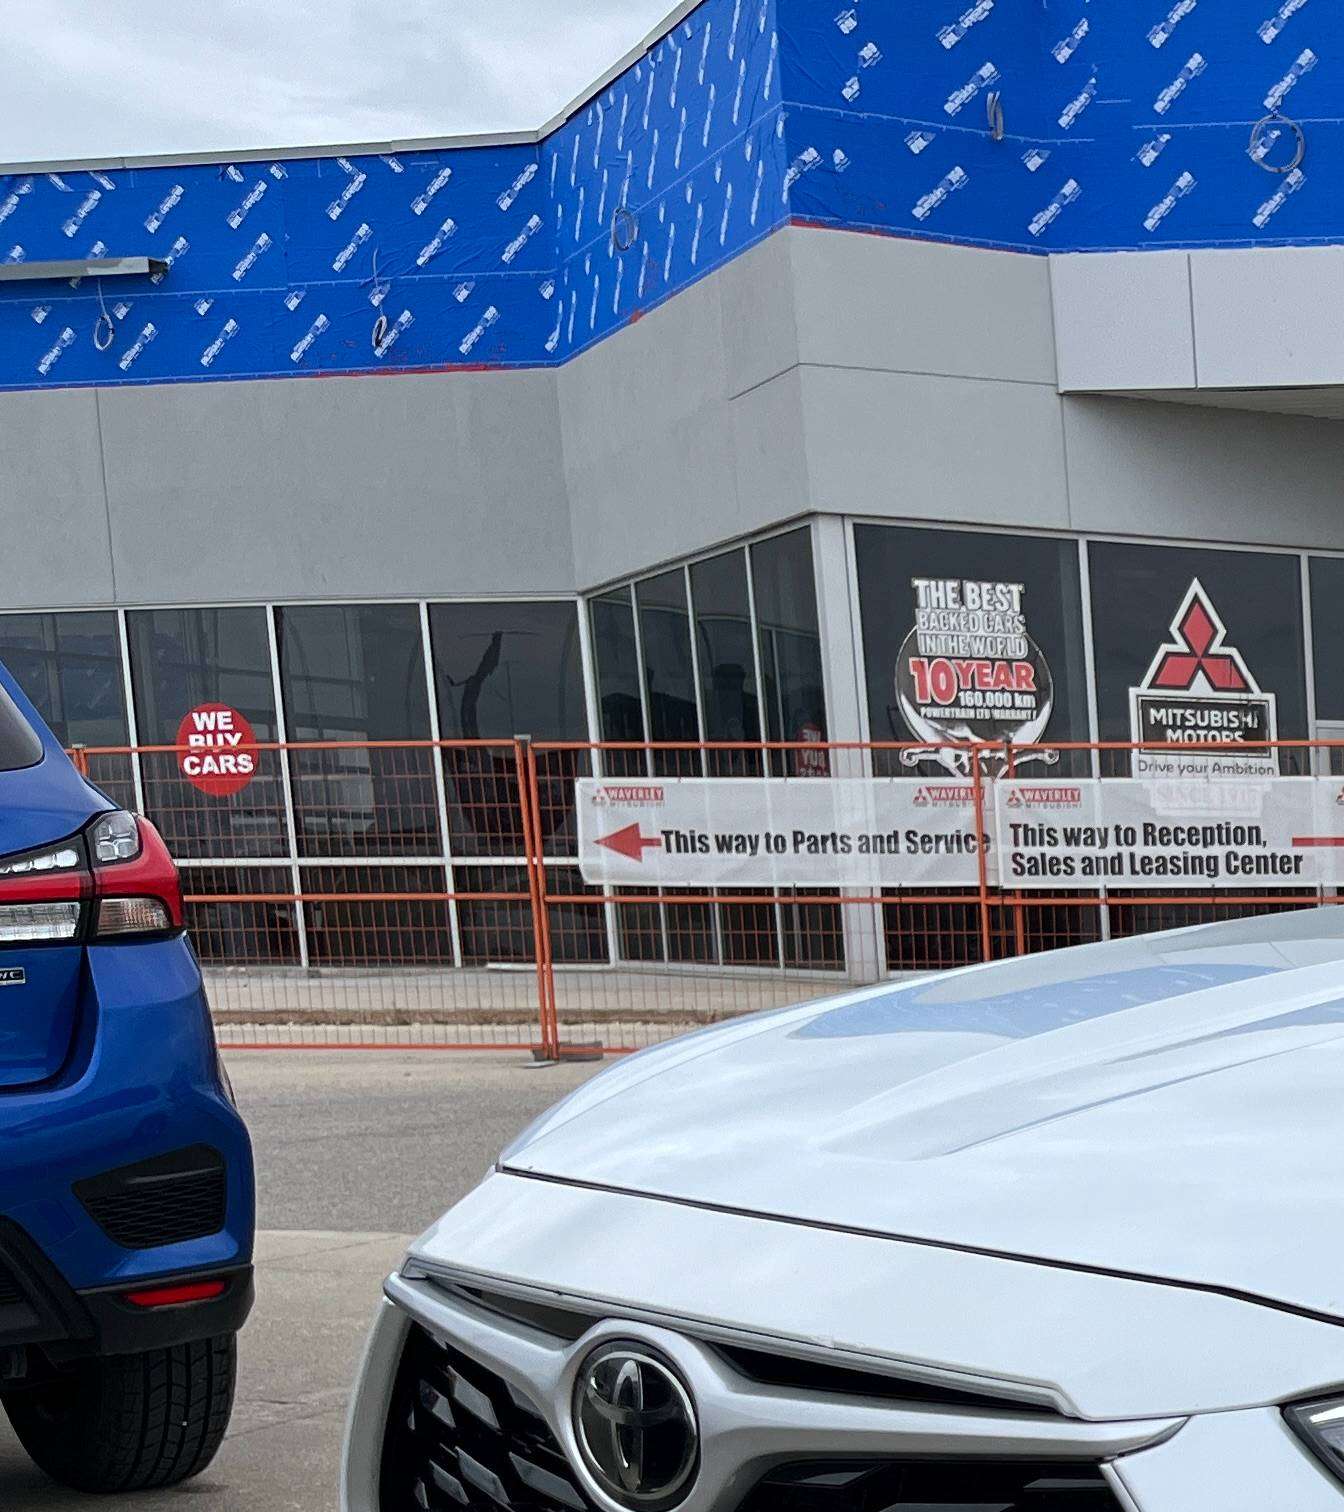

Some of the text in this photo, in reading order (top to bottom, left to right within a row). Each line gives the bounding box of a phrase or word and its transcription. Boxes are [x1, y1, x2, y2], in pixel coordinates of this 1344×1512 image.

[913, 578, 1024, 614] THE BEST
[919, 611, 1026, 634] BACKED CARS
[920, 634, 1028, 658] IN THE WORLD
[910, 657, 1036, 704] 10 YEAR
[1014, 692, 1036, 708] km
[192, 711, 233, 731] WE
[1150, 708, 1259, 729] MITSUBISHI
[188, 733, 242, 752] BUY
[1166, 729, 1245, 743] MOTORS
[183, 753, 254, 776] CARS
[1138, 760, 1275, 776] Drive your Ambition
[607, 787, 663, 800] WAVERLEY
[1024, 789, 1080, 801] WAVERLEY
[661, 830, 991, 857] This way to Parts and Service
[1010, 822, 1267, 850] This way to Reception,
[1011, 851, 1303, 878] Sales and Leasing Center
